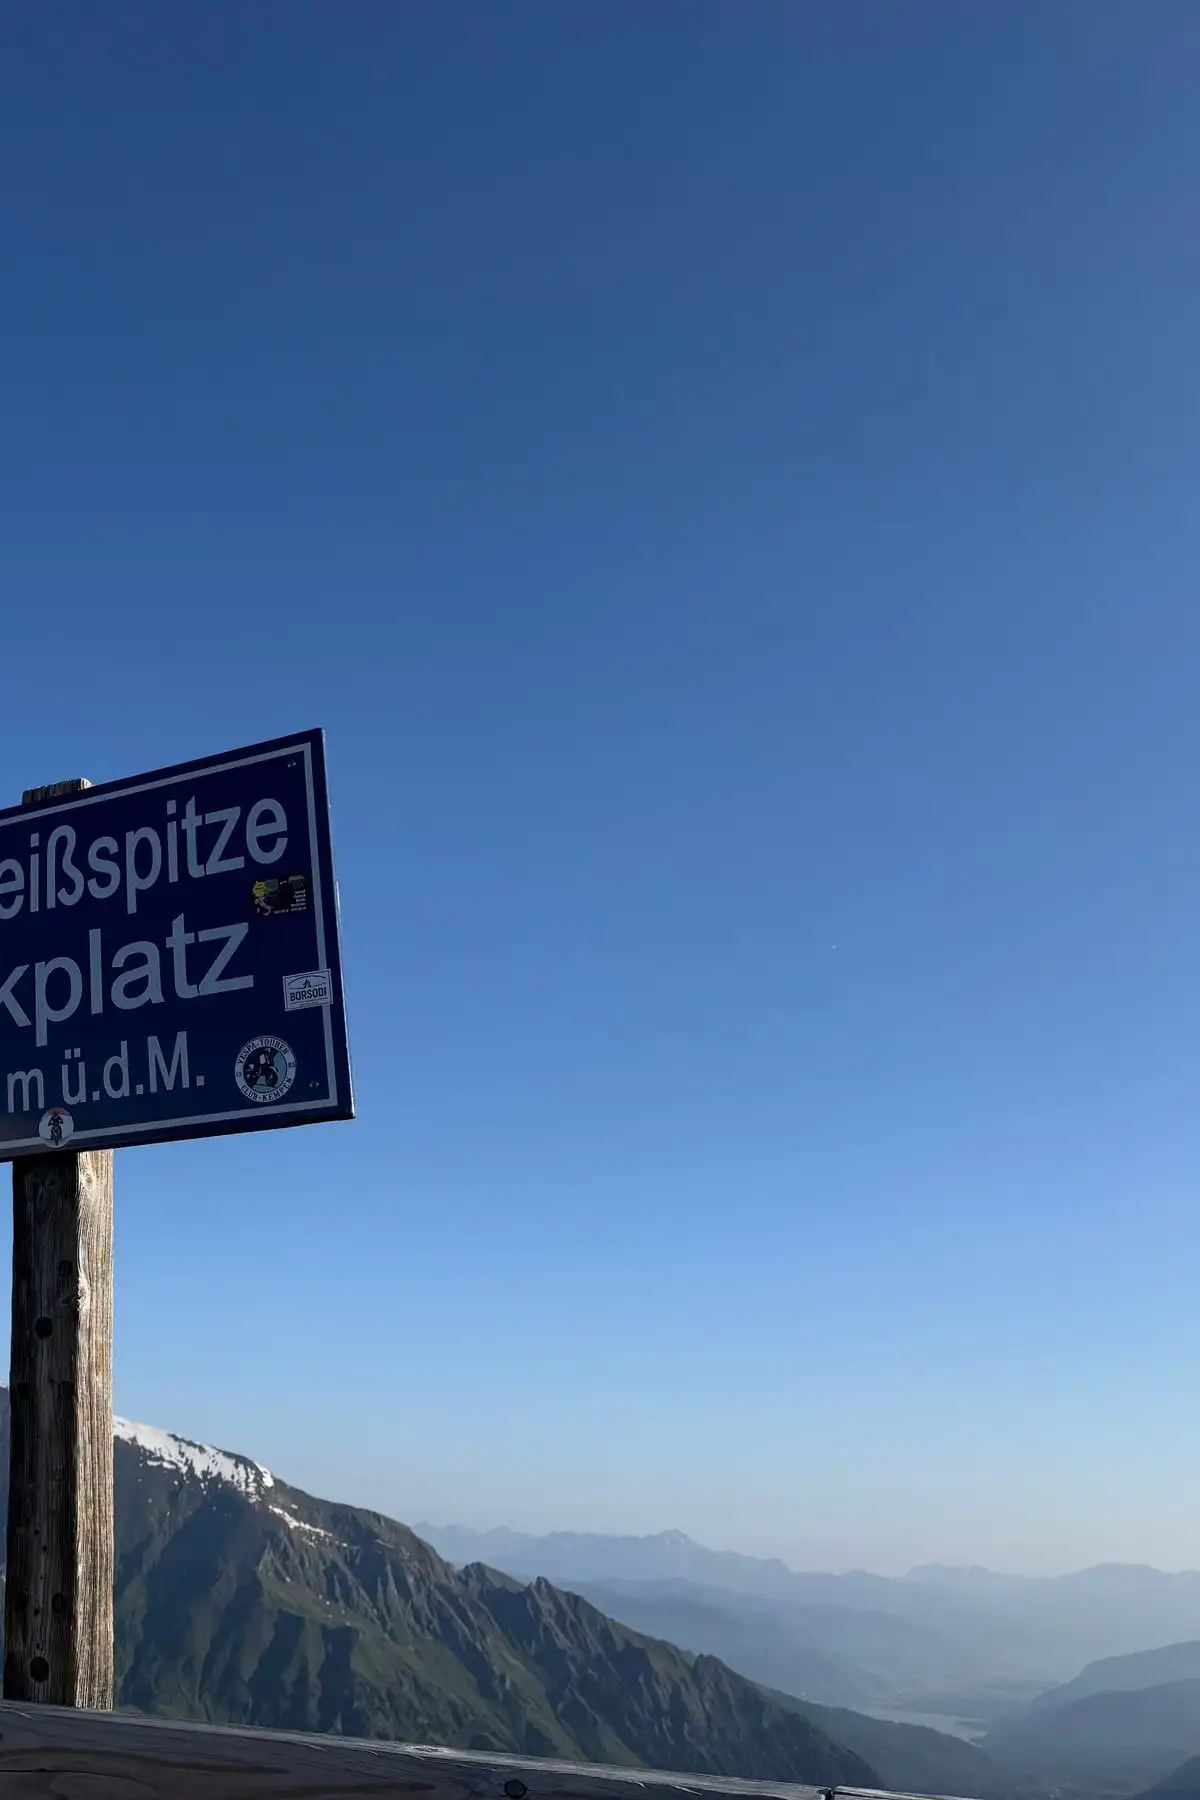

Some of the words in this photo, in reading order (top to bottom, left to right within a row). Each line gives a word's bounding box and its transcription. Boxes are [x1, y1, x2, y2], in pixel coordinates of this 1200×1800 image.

[6, 1068, 45, 1113] m
[61, 1030, 205, 1106] ü.d.M.
[241, 1085, 258, 1100] CLUB
[262, 1077, 292, 1102] KEMPEN
